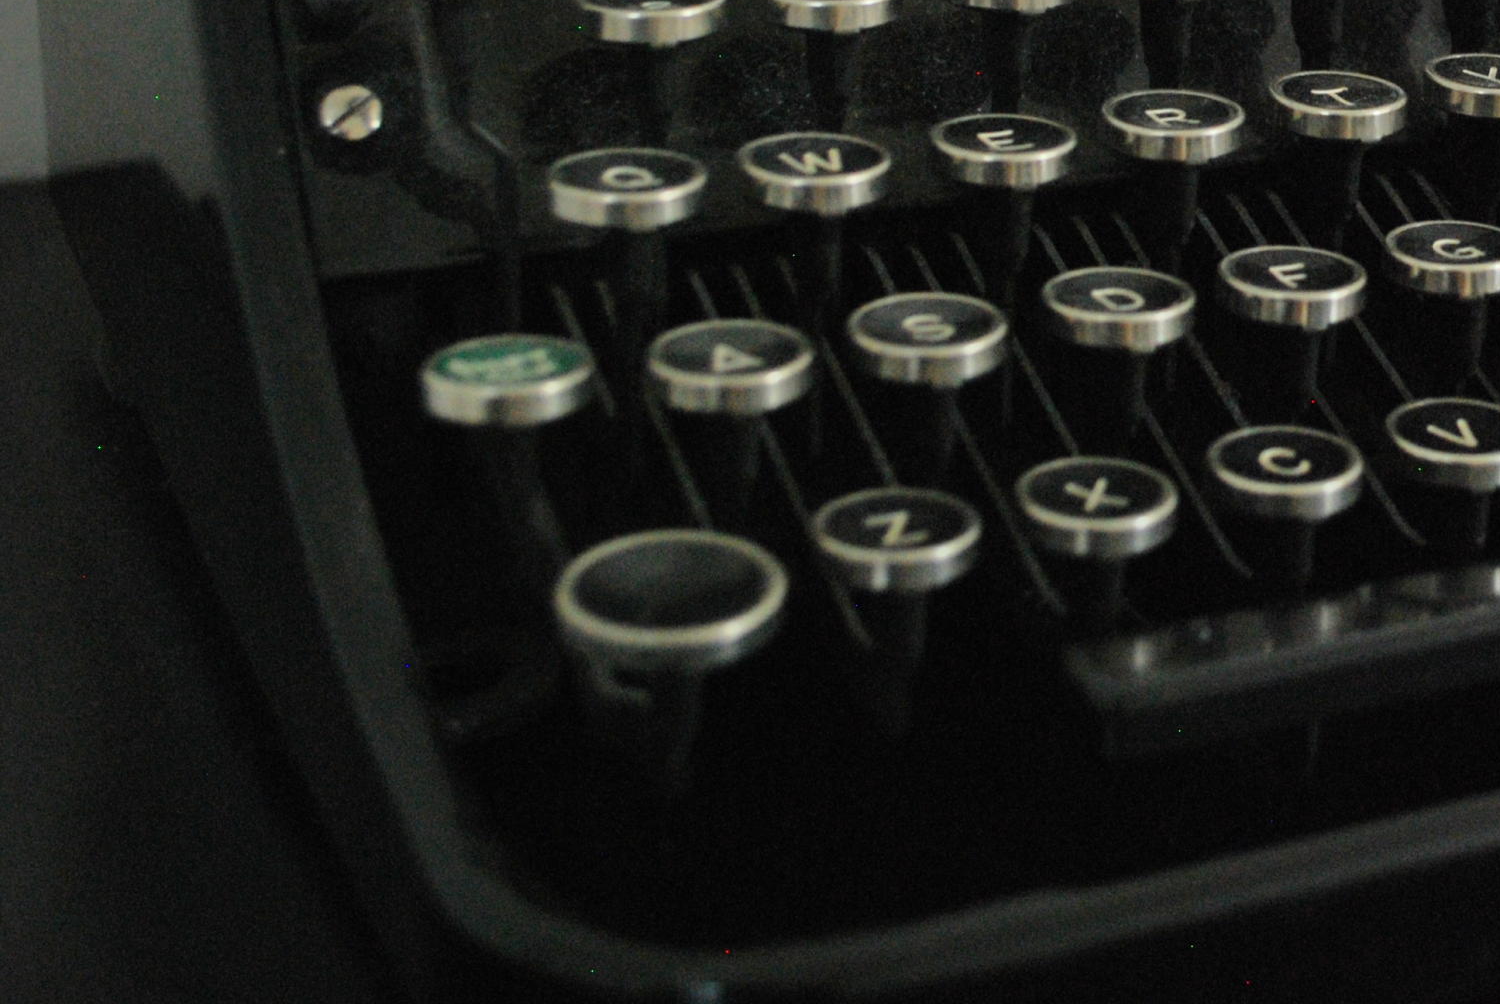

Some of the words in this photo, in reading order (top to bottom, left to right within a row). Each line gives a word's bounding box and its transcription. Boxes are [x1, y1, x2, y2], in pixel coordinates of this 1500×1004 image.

[1310, 85, 1355, 108] T
[1144, 107, 1200, 127] R
[977, 129, 1032, 153] E
[777, 147, 842, 174] W
[1431, 238, 1485, 260] G
[1268, 262, 1307, 288] F
[1090, 286, 1144, 312] D
[901, 313, 955, 341] S
[711, 343, 762, 371] A
[1427, 417, 1479, 449] V
[1257, 446, 1311, 477] C
[1064, 477, 1128, 512] X
[865, 510, 932, 548] Z
